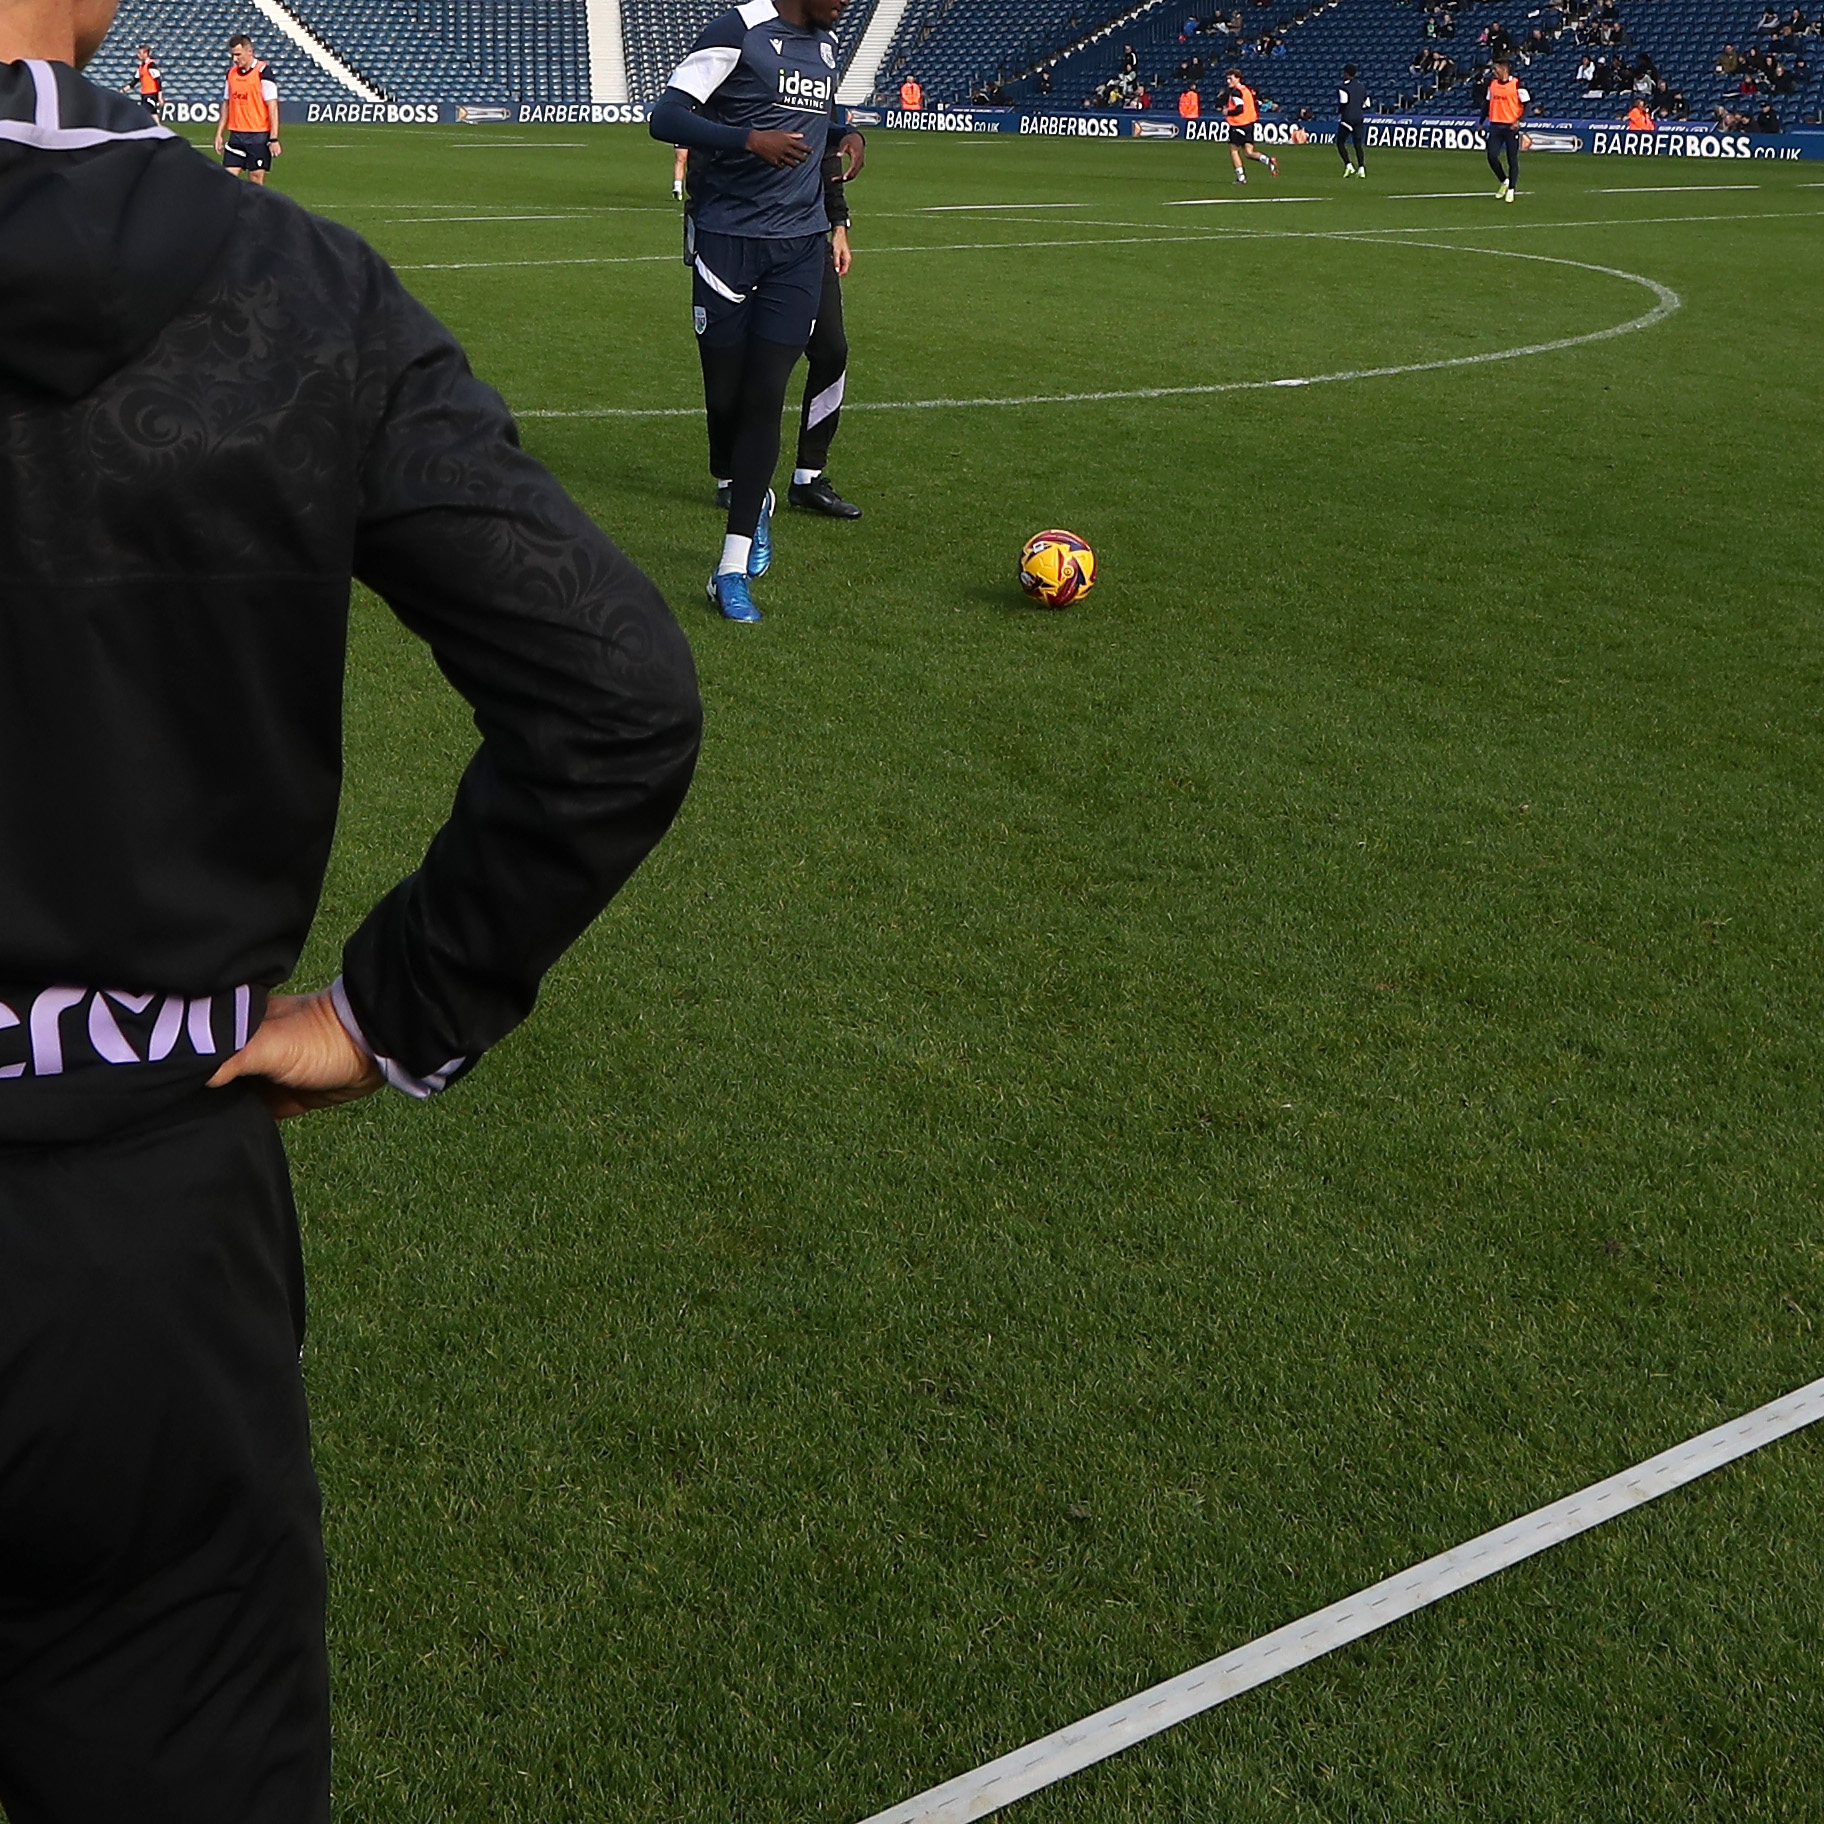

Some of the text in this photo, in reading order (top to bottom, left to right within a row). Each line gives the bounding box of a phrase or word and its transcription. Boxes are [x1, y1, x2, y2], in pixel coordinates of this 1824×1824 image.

[778, 69, 832, 101] ideal
[307, 103, 439, 123] BARBERBOSS
[783, 96, 825, 110] HEATING
[1019, 115, 1119, 138] BARBERBOSS
